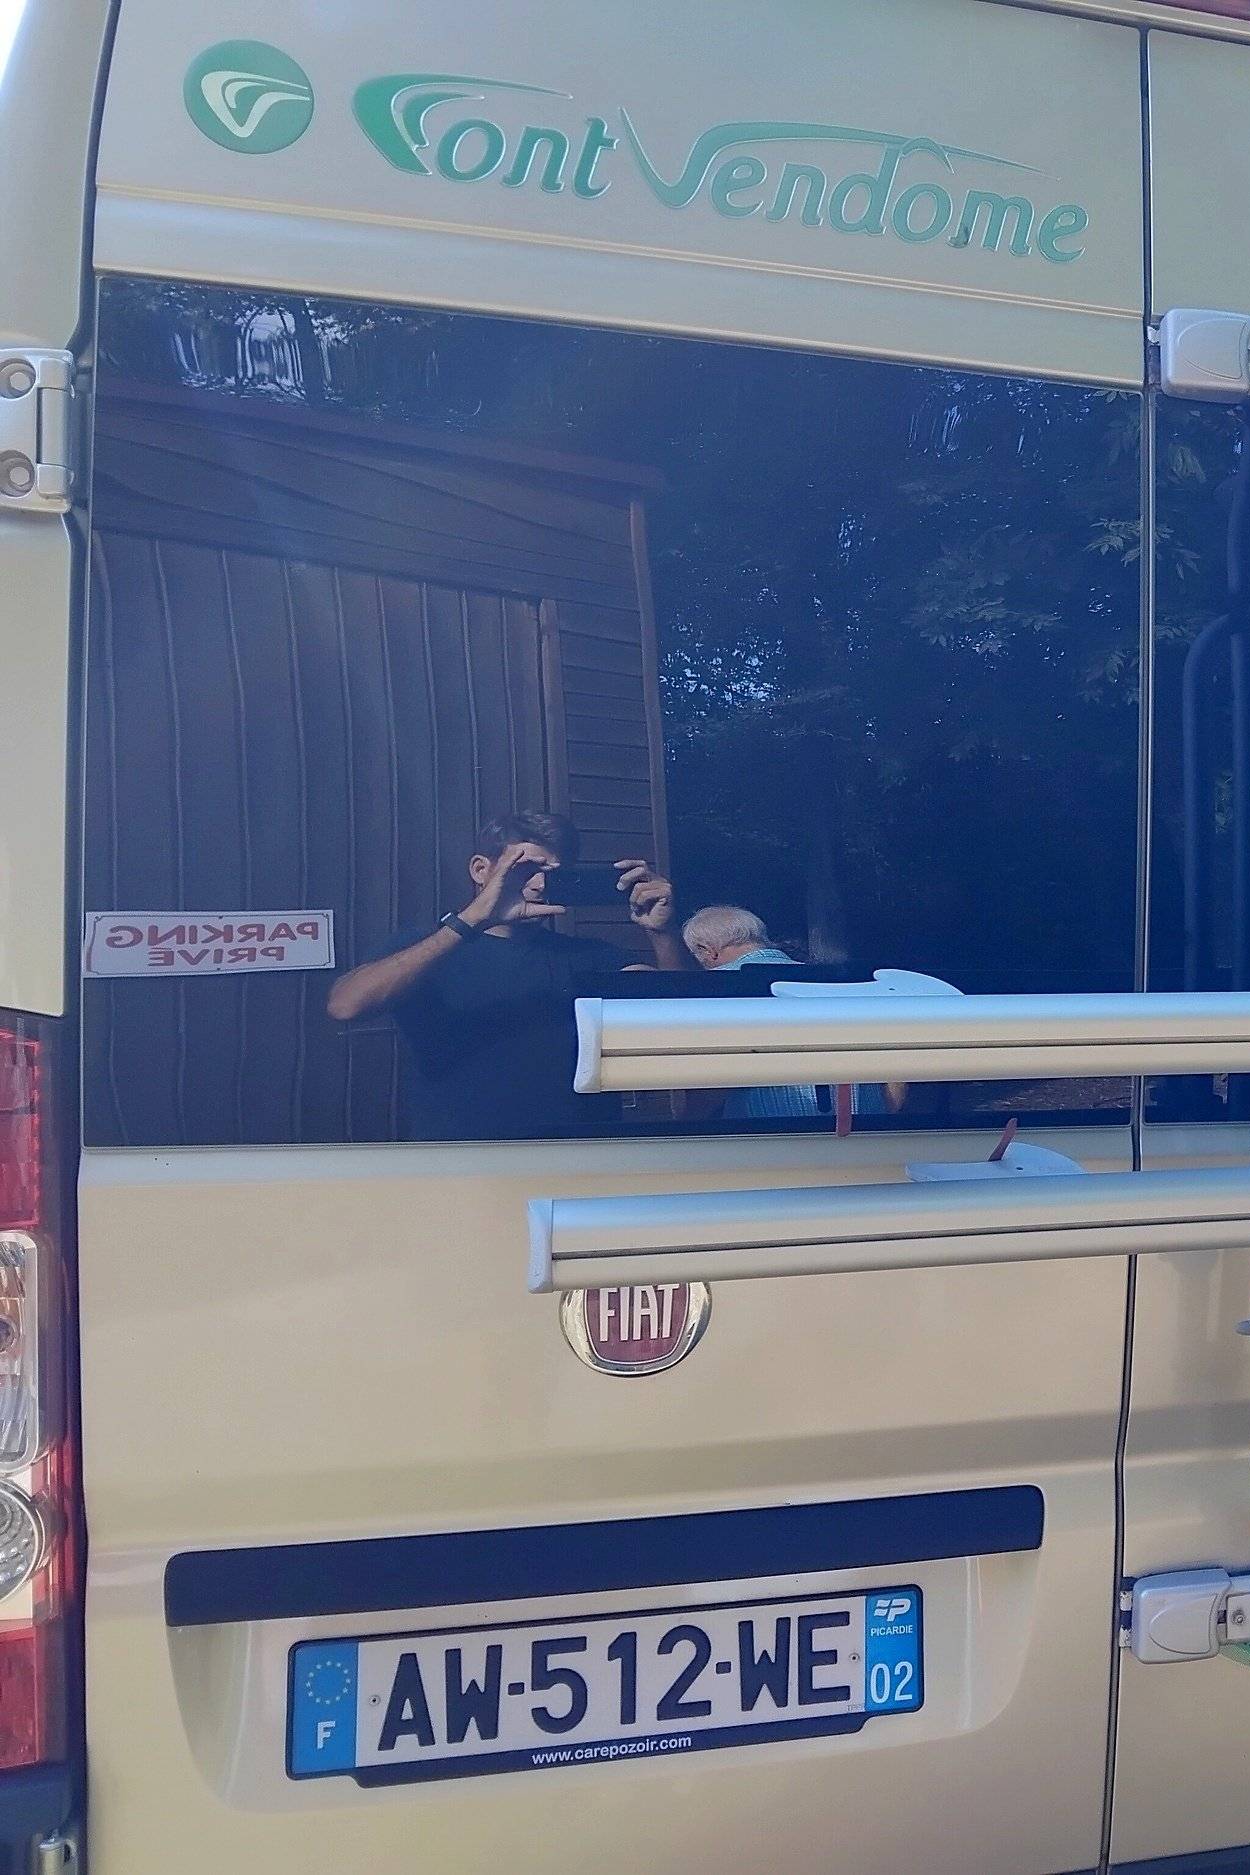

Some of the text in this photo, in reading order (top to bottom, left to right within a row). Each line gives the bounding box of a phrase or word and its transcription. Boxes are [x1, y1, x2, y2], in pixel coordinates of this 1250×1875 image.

[599, 1284, 680, 1342] FIAT
[870, 1624, 913, 1637] PICARDIE
[377, 1610, 851, 1752] AW-512-WE
[870, 1661, 913, 1704] 02
[316, 1721, 336, 1751] F
[531, 1735, 692, 1766] www.carepozoir.com
